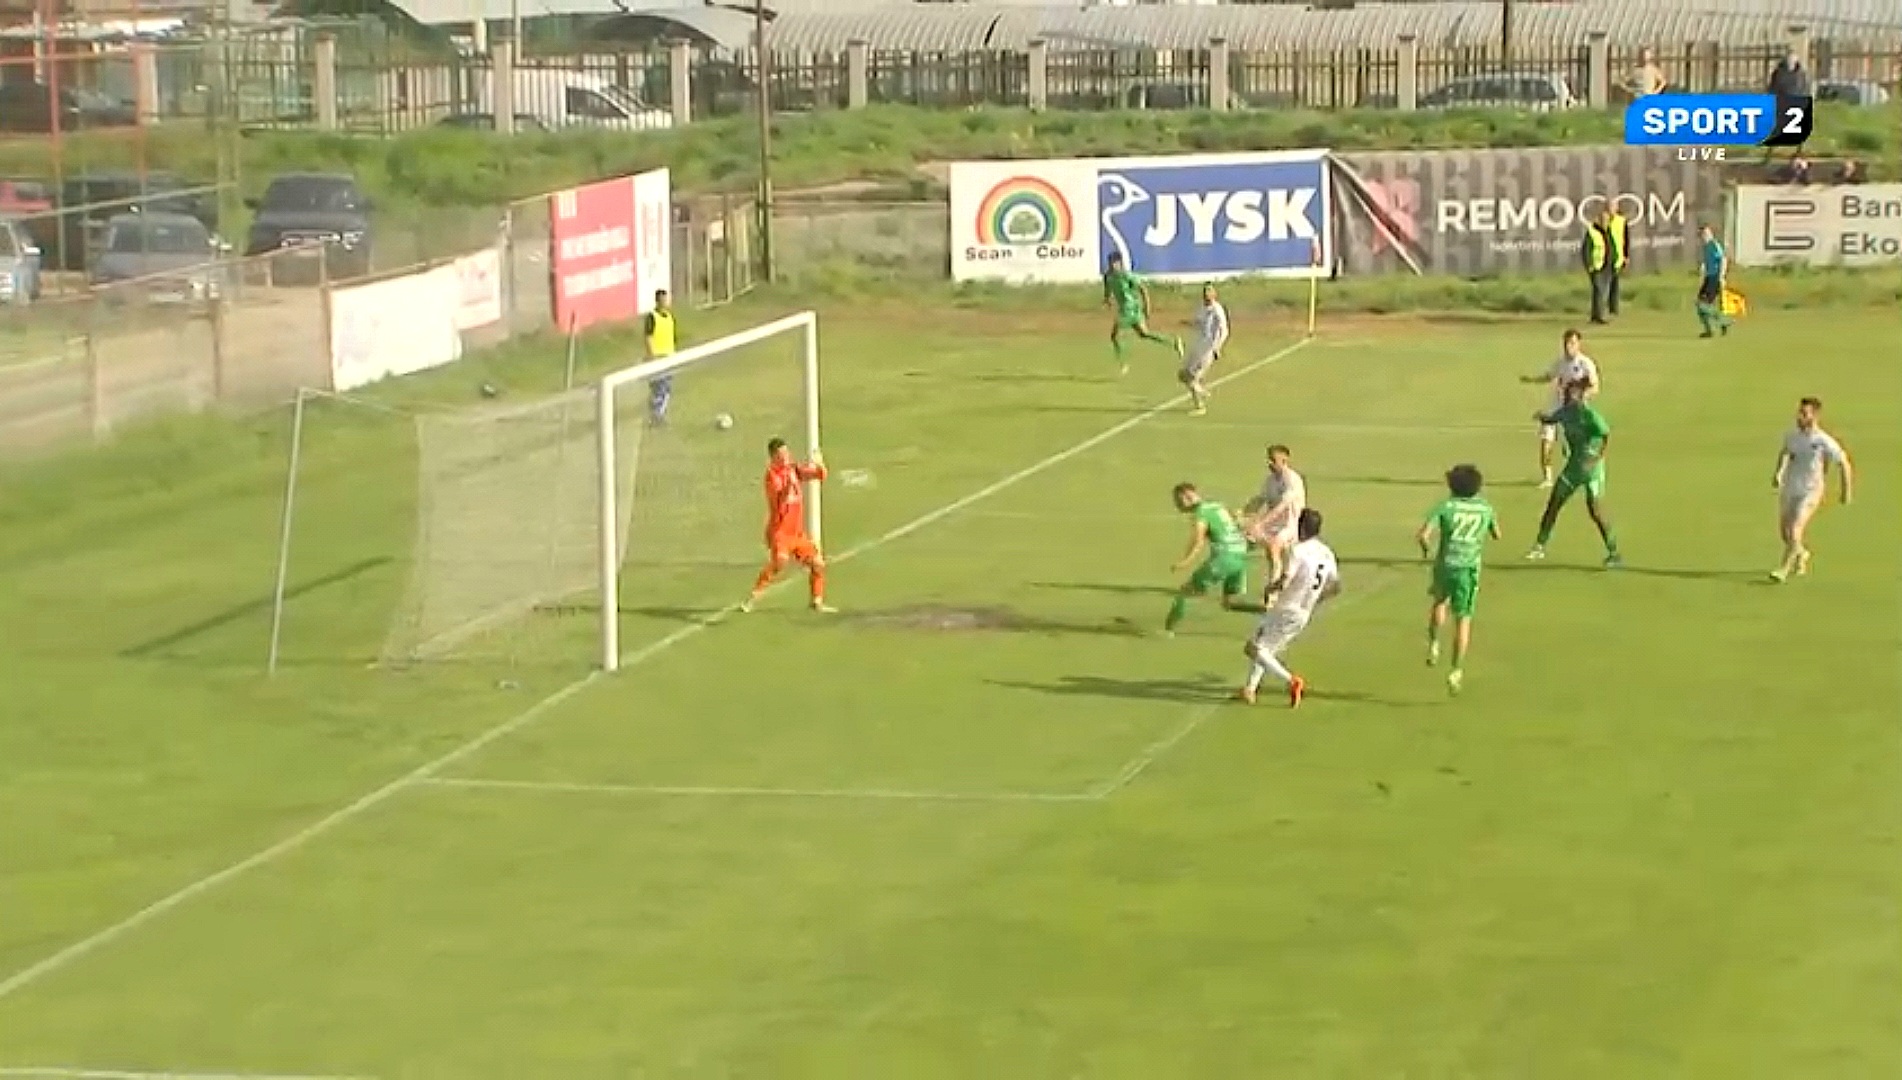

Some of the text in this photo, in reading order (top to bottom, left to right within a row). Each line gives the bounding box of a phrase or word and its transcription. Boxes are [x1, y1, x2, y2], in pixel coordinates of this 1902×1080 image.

[1144, 187, 1320, 247] JYSK
[1437, 191, 1686, 233] REMOCOM
[964, 244, 1086, 262] Scan Color
[1450, 511, 1482, 542] 22
[1311, 563, 1325, 591] 5
